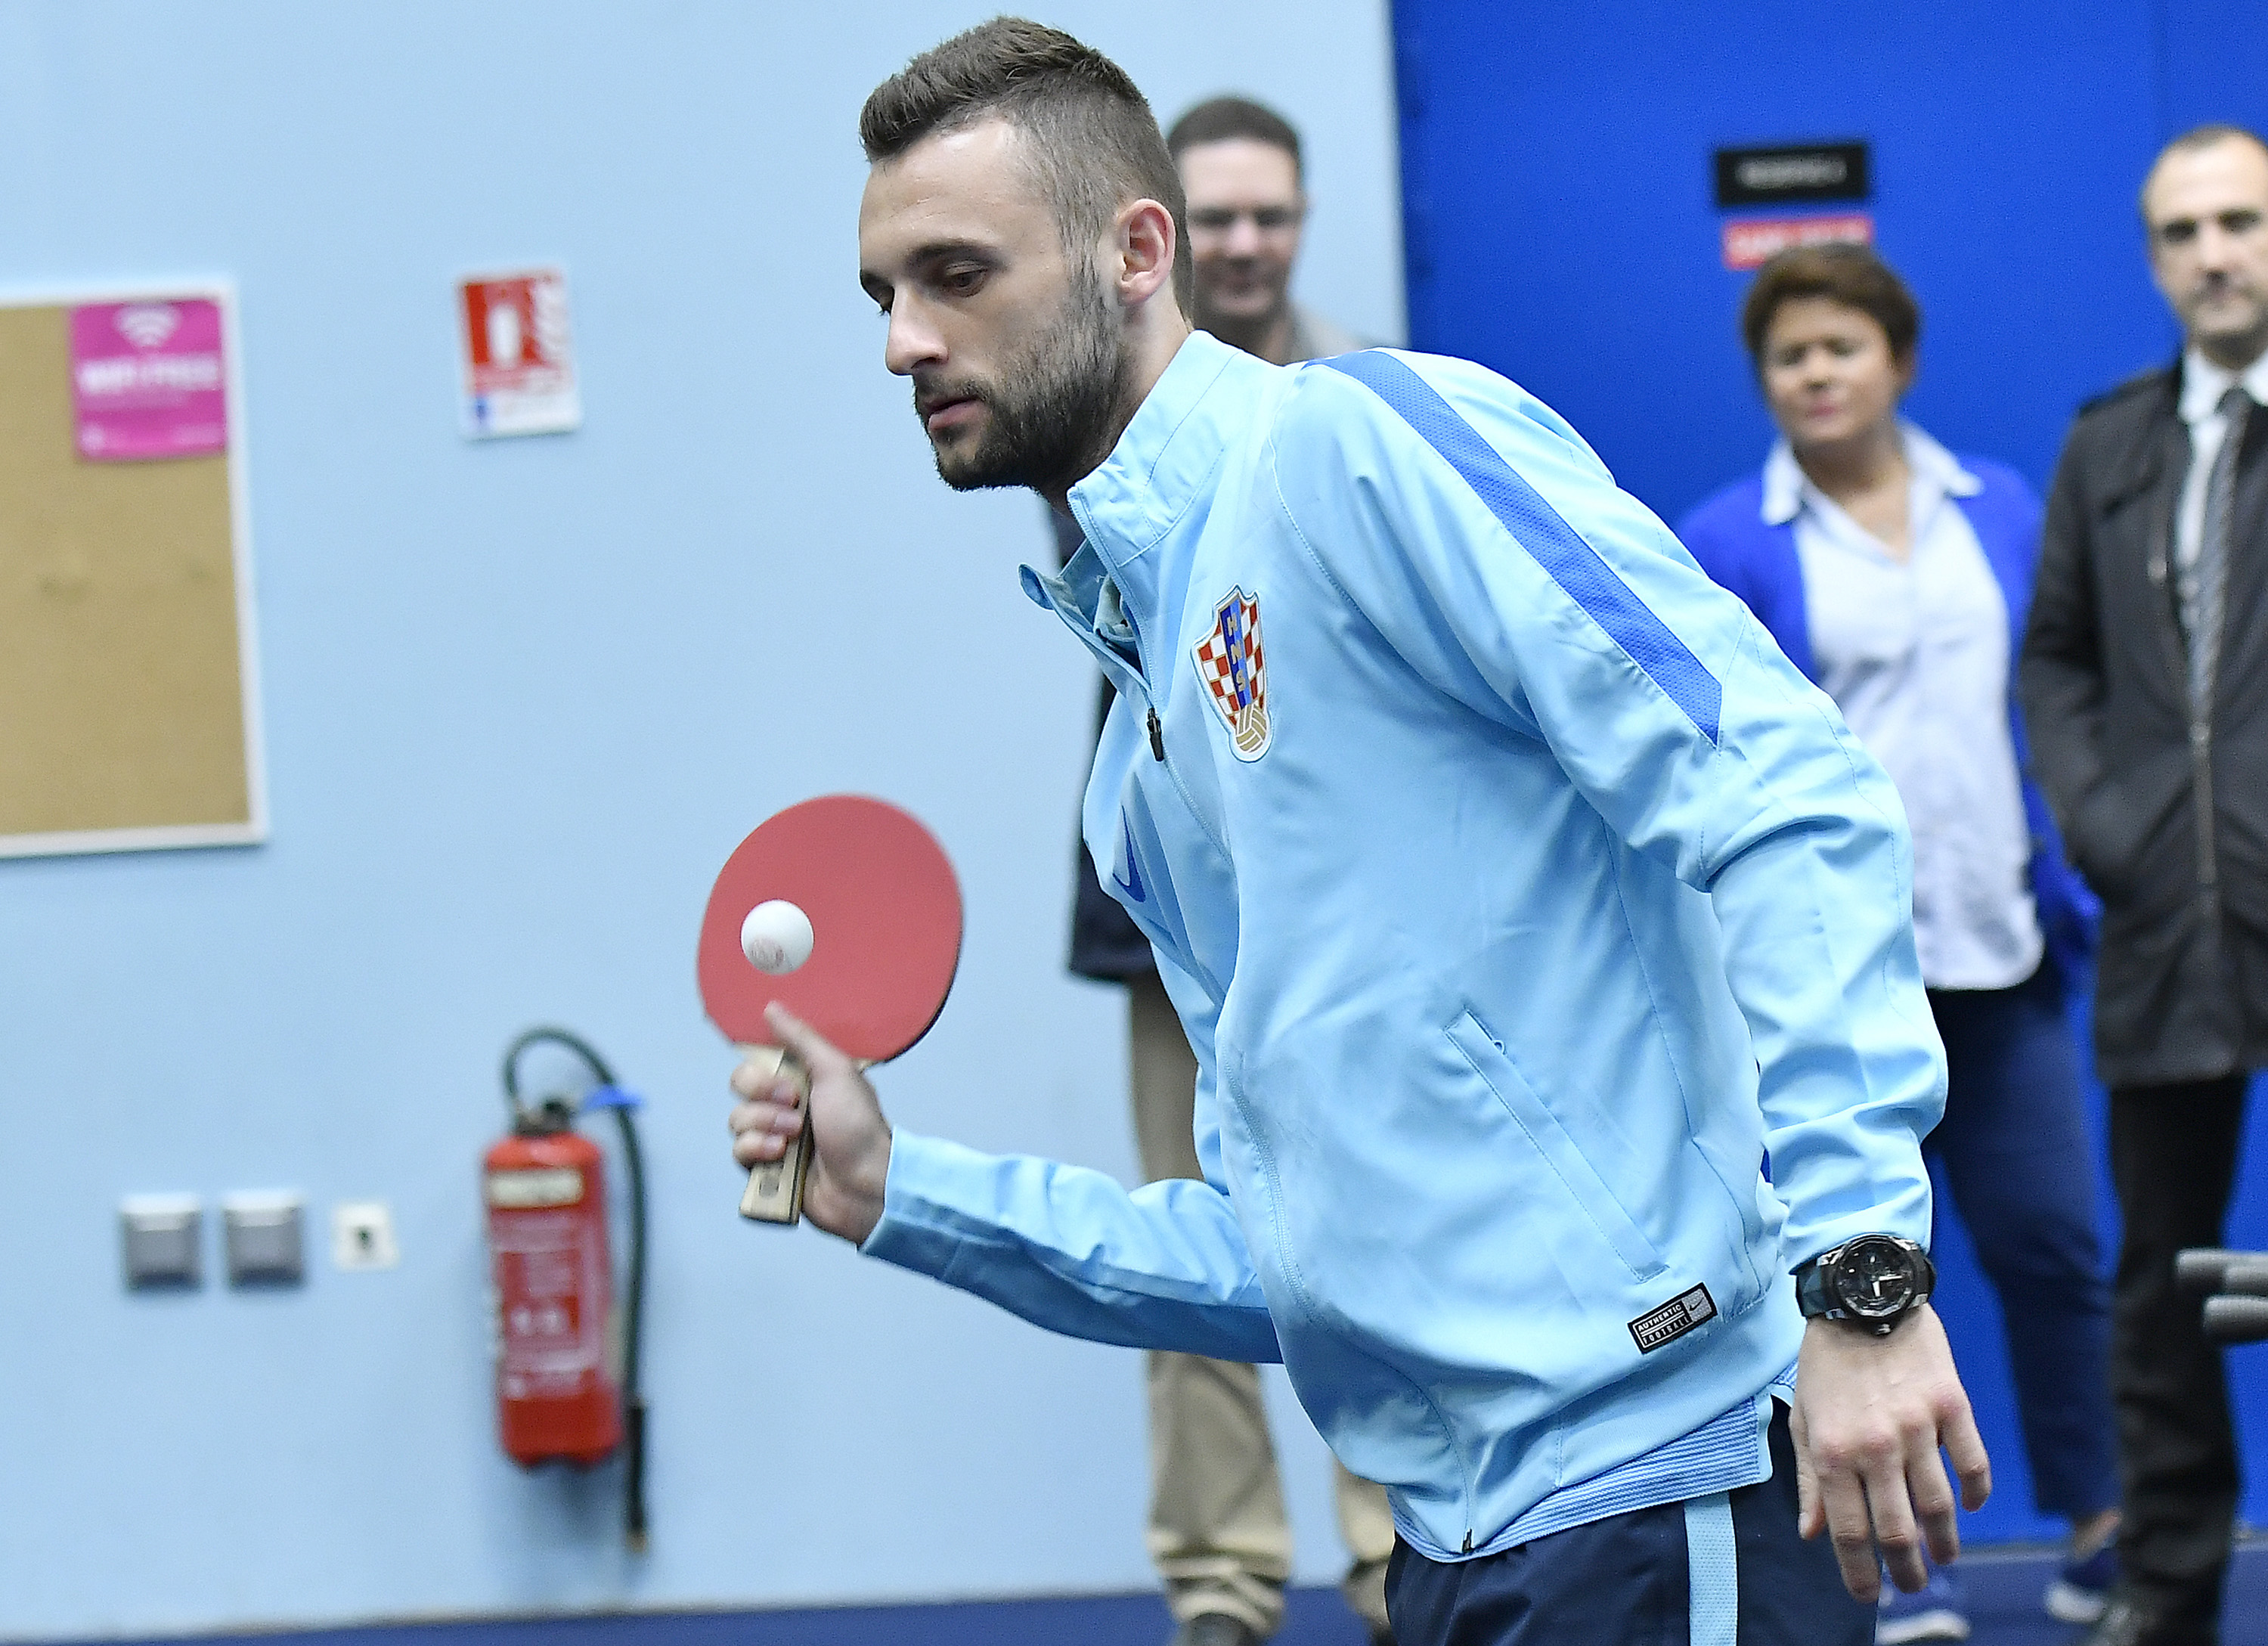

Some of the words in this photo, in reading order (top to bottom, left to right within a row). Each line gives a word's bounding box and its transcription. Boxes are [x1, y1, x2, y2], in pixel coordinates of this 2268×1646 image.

[1226, 613, 1246, 691] HNS
[1637, 1304, 1682, 1331] AUTHENTIC
[1643, 1316, 1690, 1344] FOOTBALL
